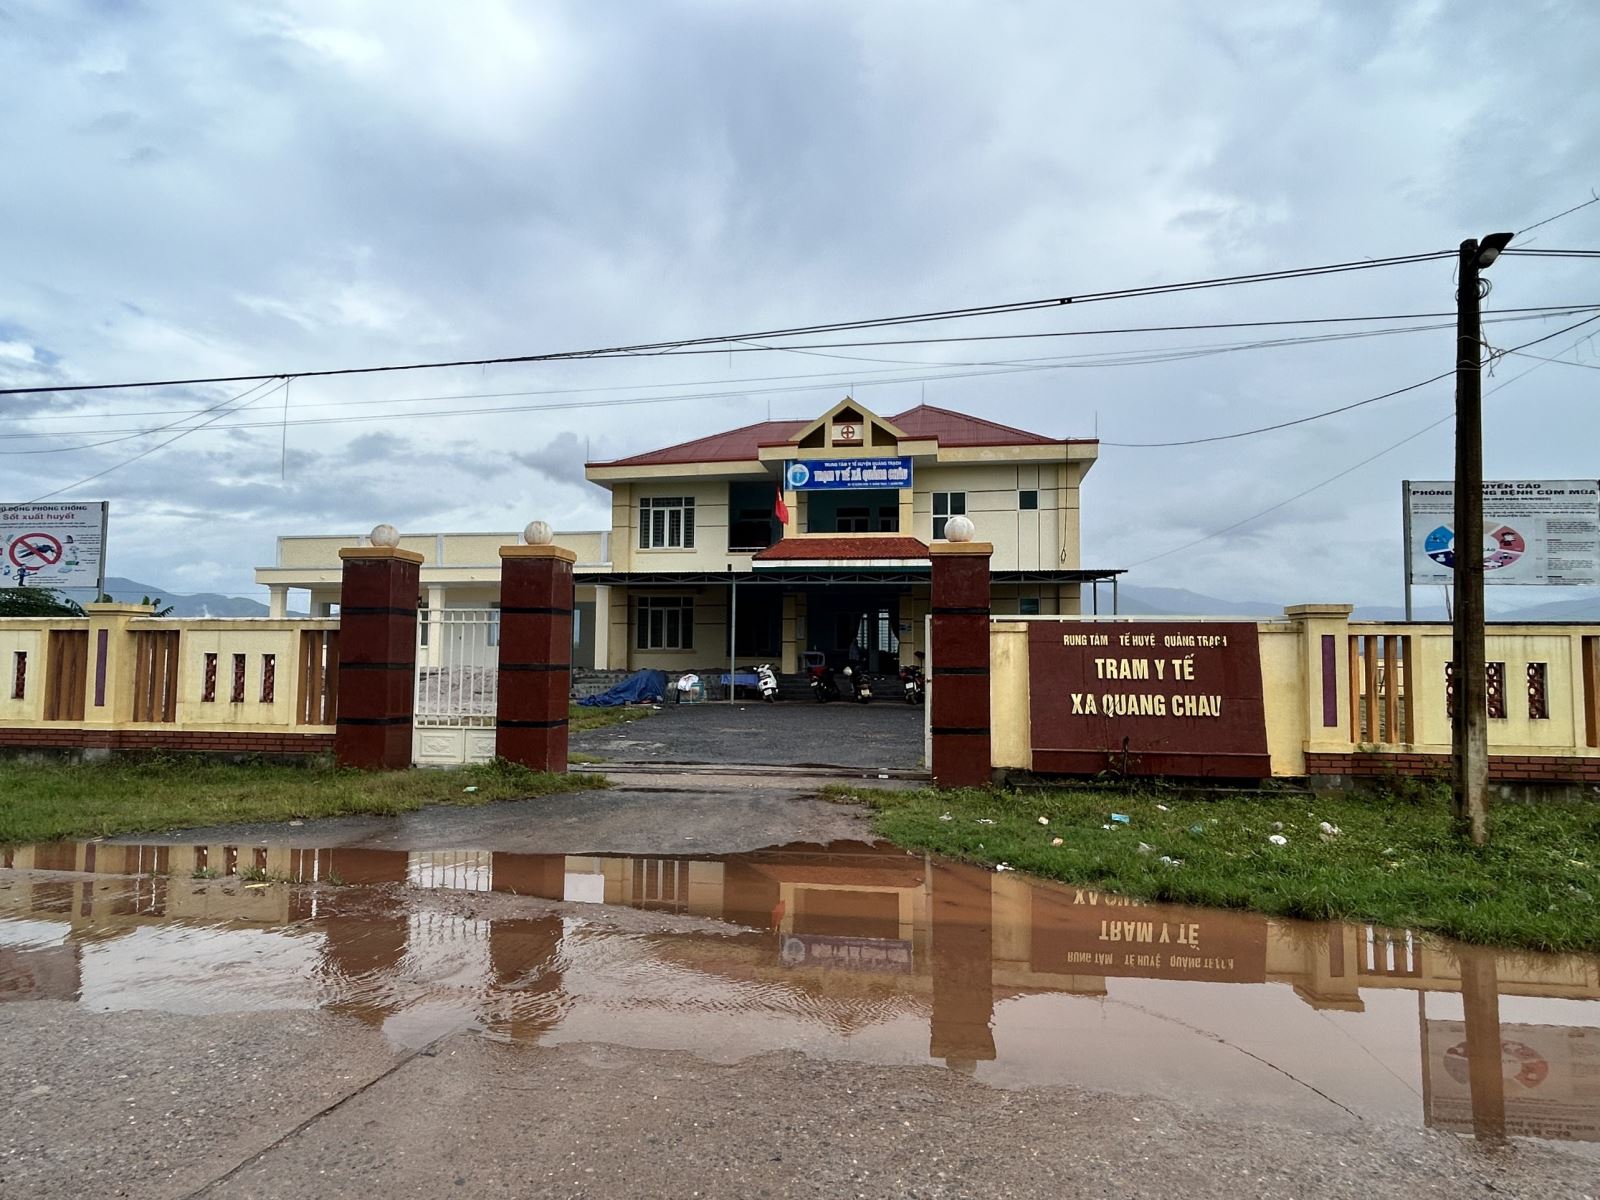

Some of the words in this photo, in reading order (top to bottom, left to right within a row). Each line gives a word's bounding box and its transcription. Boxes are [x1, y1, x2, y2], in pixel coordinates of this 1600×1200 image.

[1119, 631, 1131, 646] TẾ
[1164, 631, 1196, 648] QUẢNG
[1094, 658, 1149, 680] TRAM
[1153, 659, 1166, 680] Y
[1172, 653, 1195, 681] TẾ
